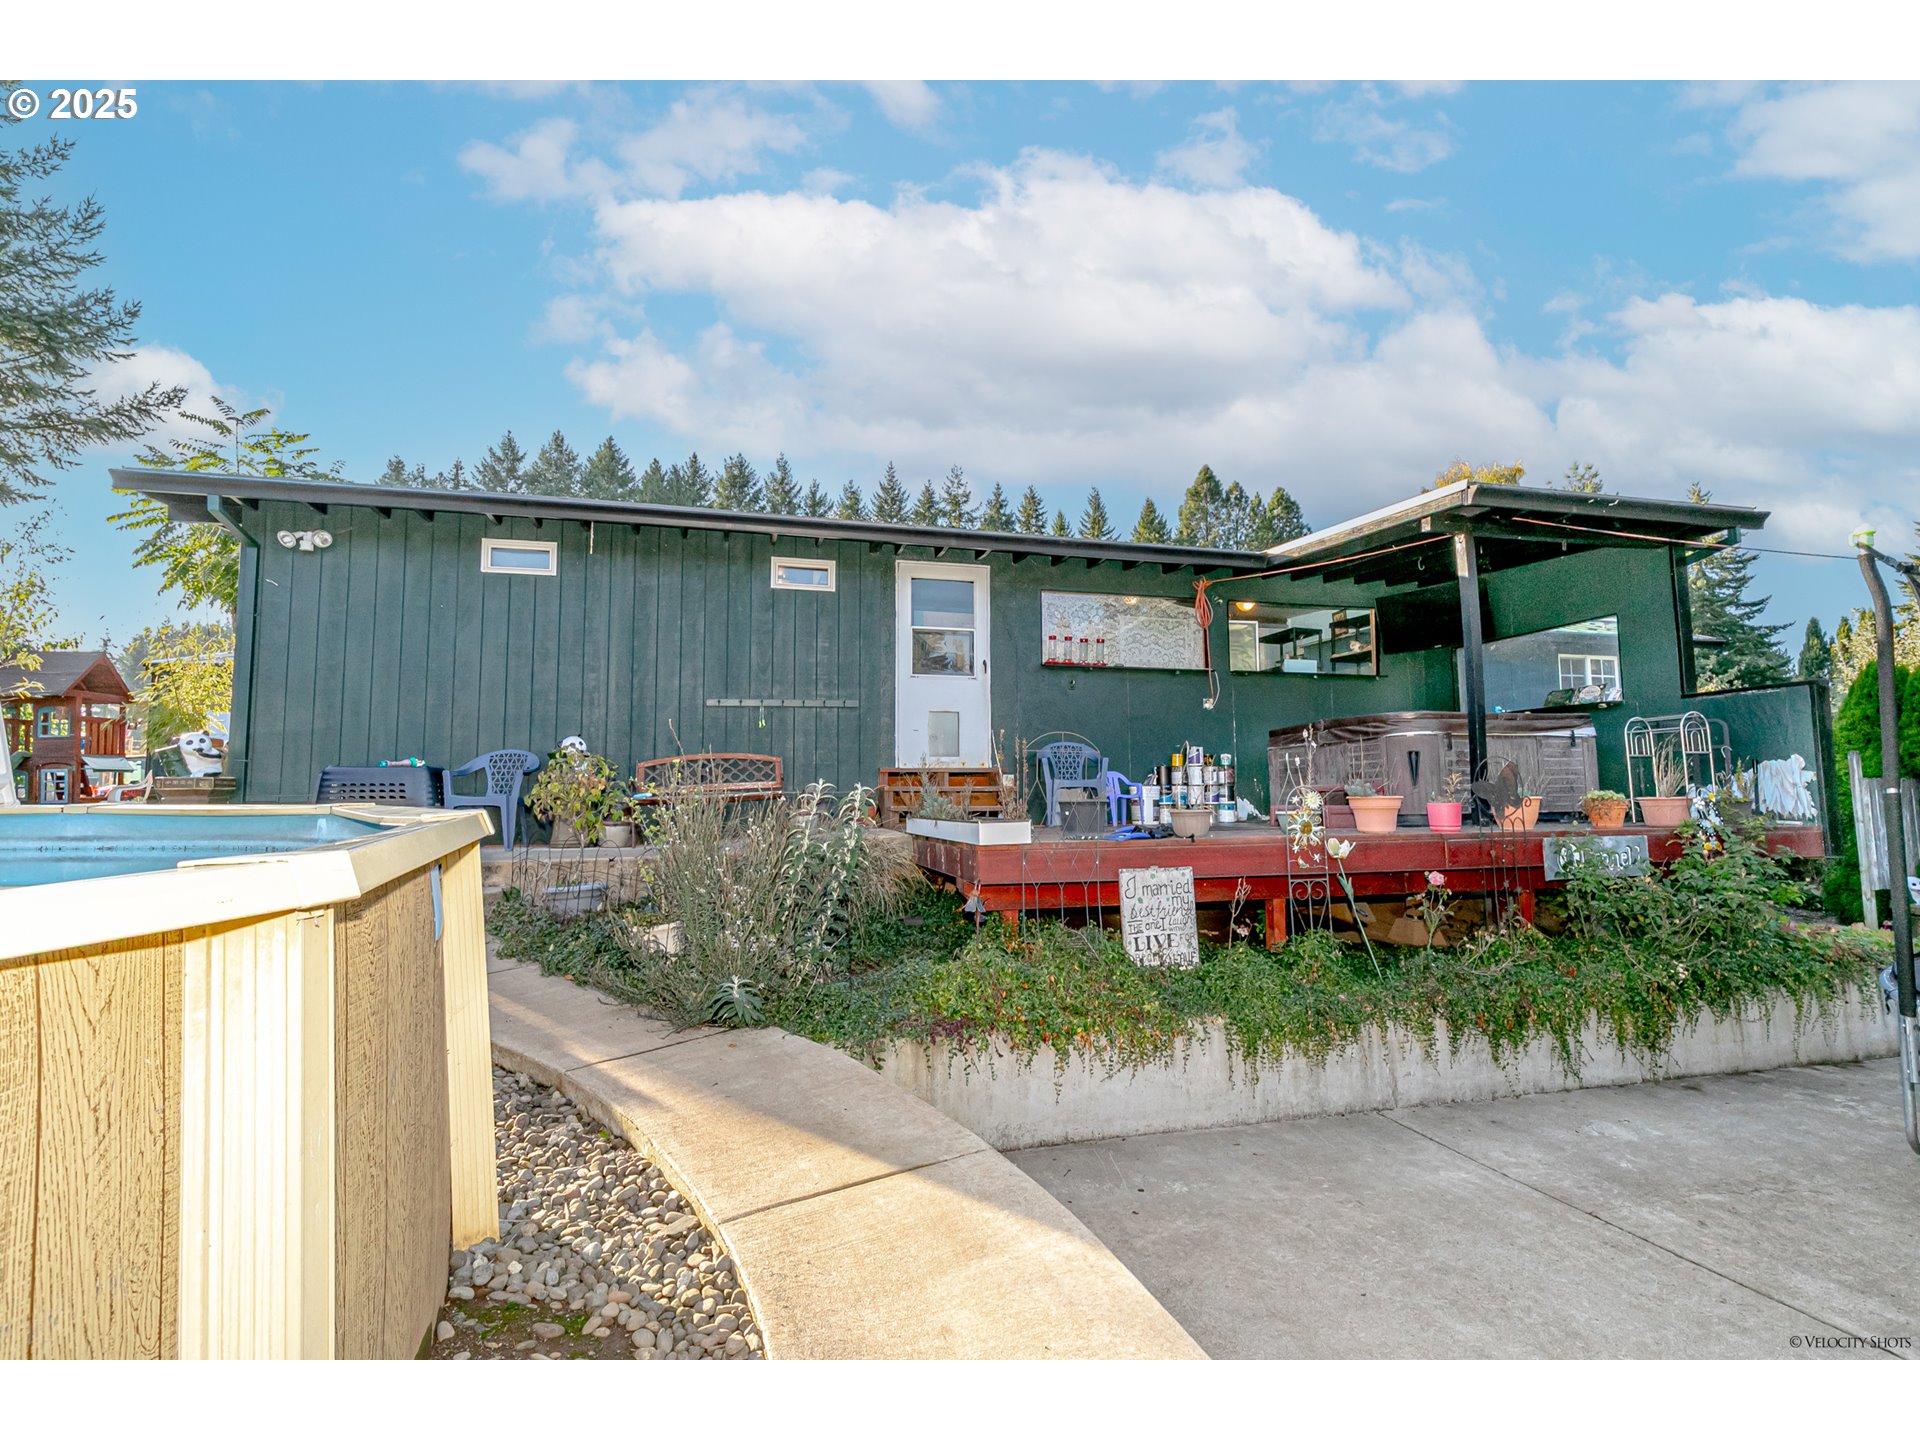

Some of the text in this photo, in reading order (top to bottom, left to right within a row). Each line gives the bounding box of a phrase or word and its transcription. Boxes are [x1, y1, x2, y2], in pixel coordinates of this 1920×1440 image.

[1124, 875, 1192, 899] I married
[1130, 900, 1194, 920] best friend
[1172, 896, 1190, 909] my
[1128, 923, 1144, 934] THE
[1145, 920, 1161, 931] one
[1160, 917, 1167, 931] I
[1133, 933, 1180, 952] LIVE
